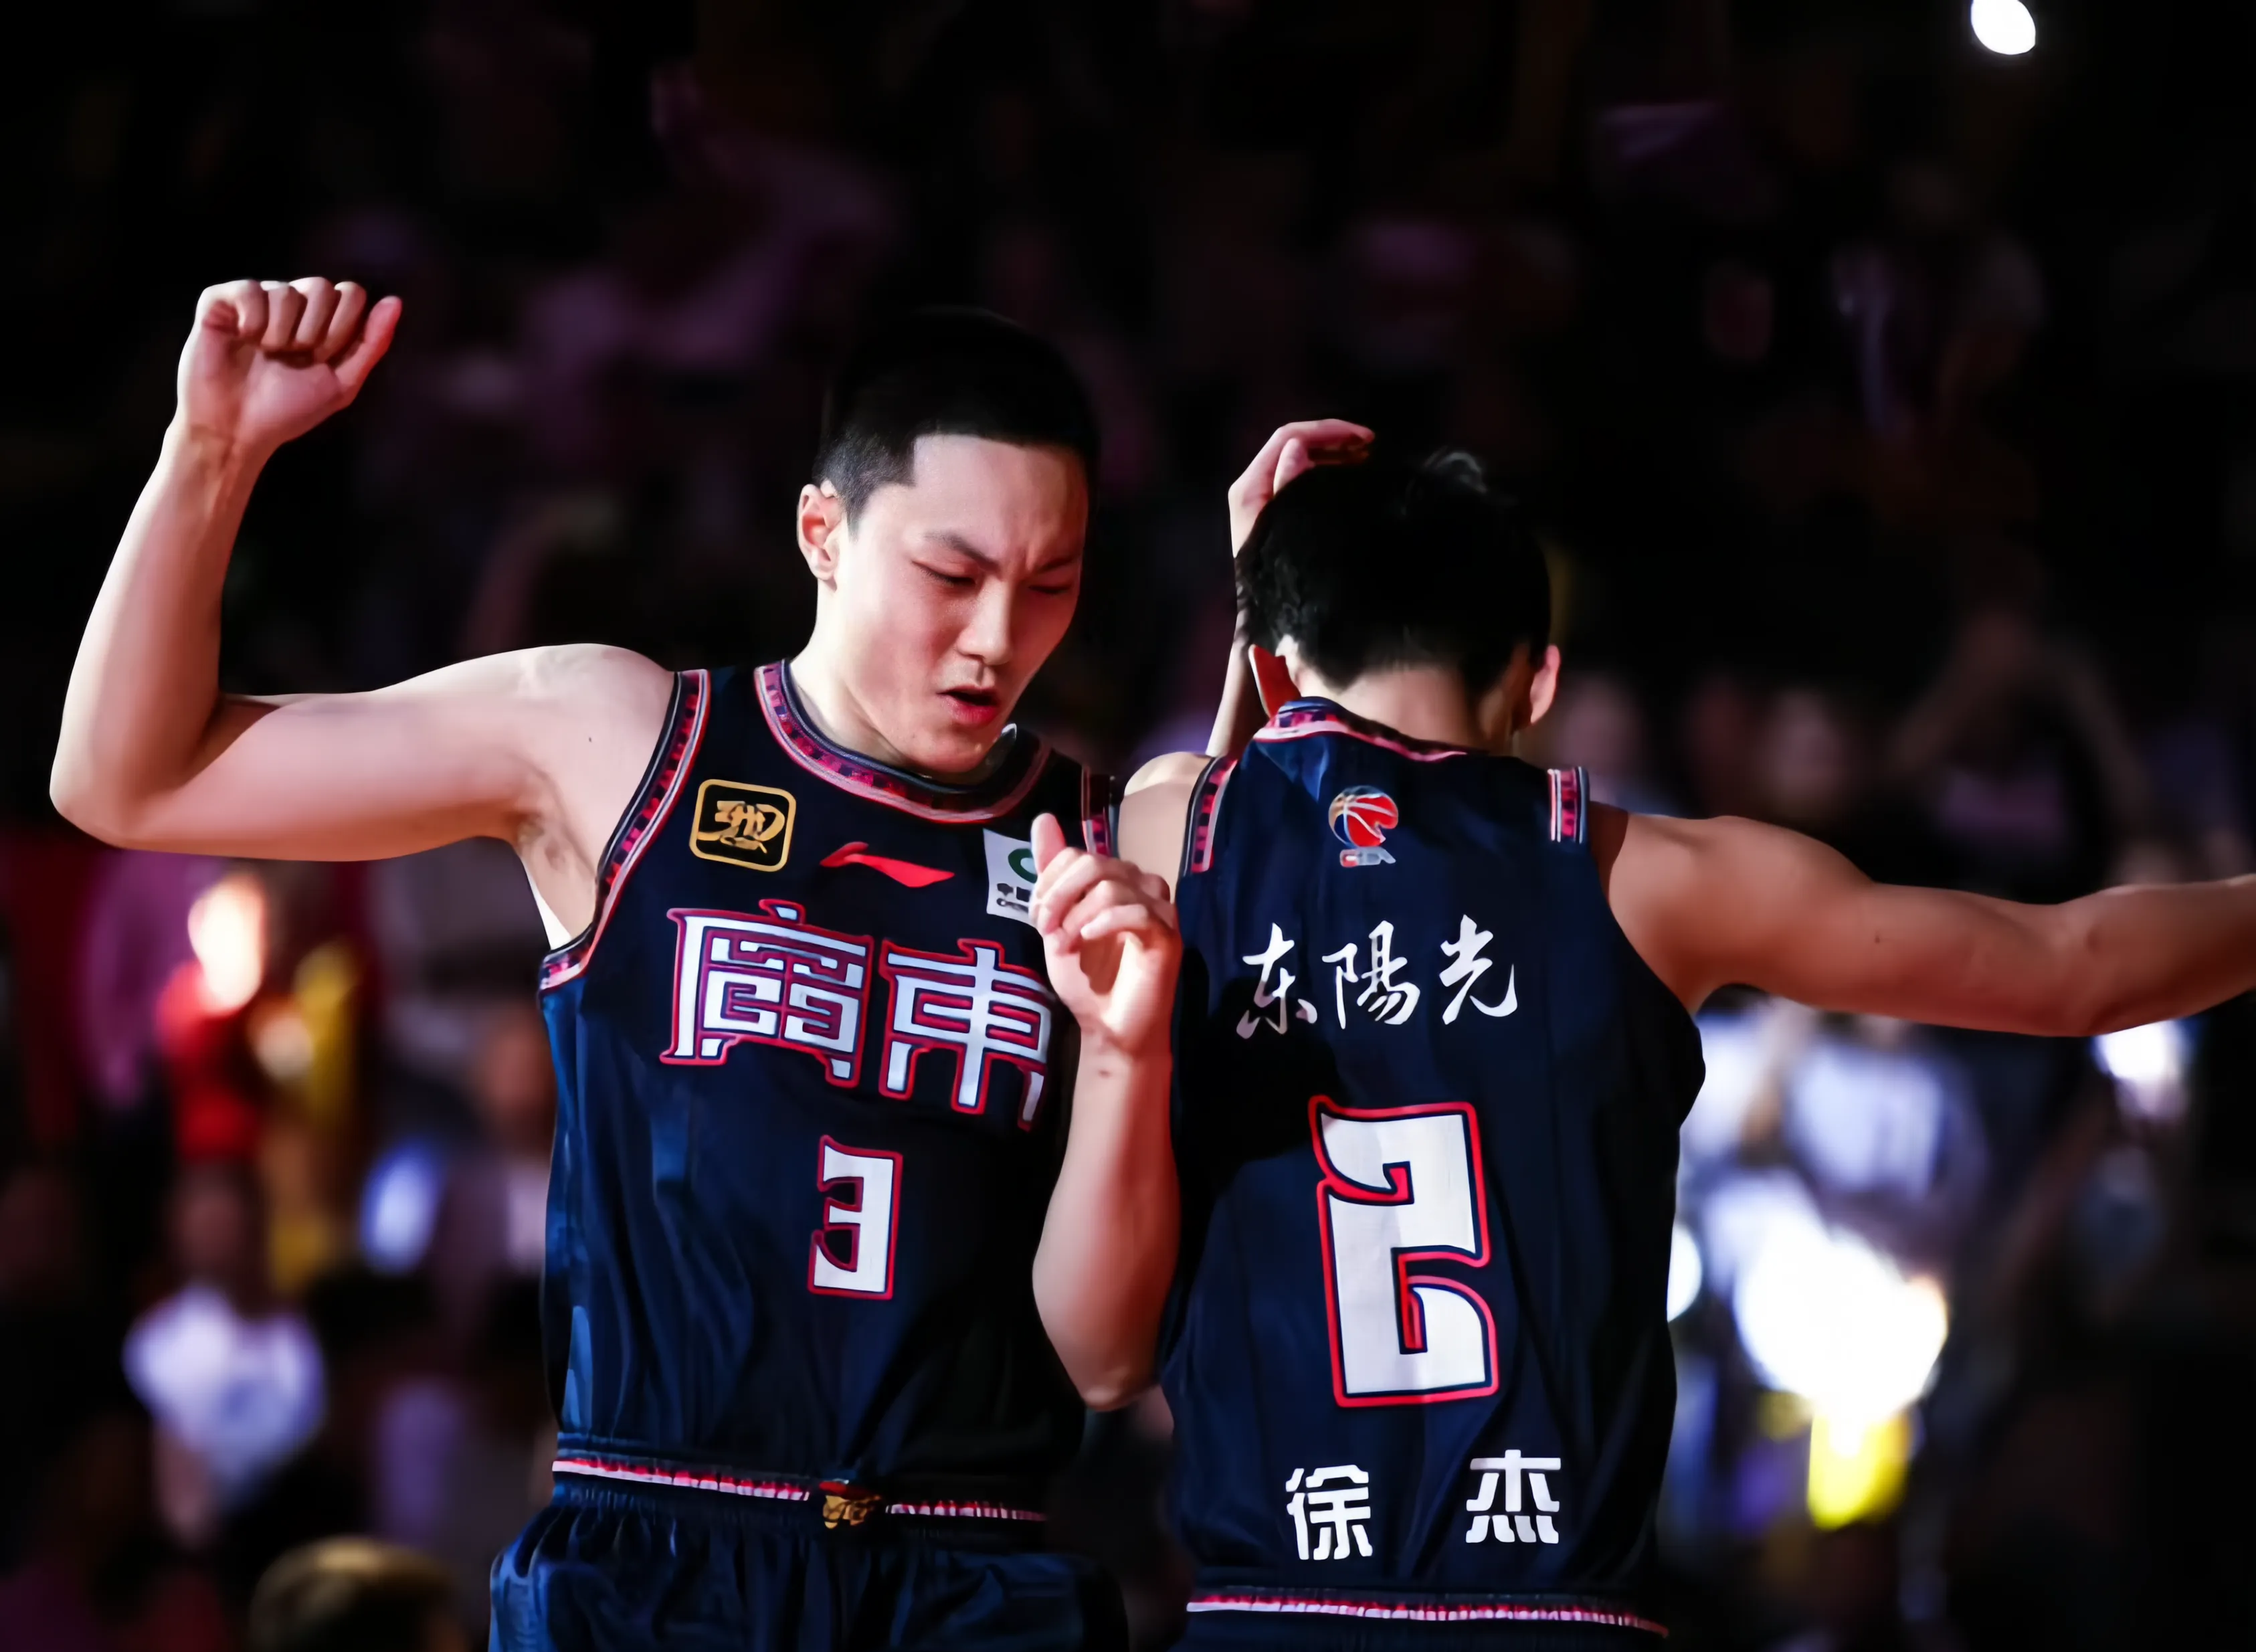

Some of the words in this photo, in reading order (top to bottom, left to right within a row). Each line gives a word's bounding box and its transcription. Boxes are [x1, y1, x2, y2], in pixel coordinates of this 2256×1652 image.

[808, 1135, 903, 1299] 3
[1309, 1096, 1499, 1407] 2
[1285, 1449, 1561, 1560] 徐杰
